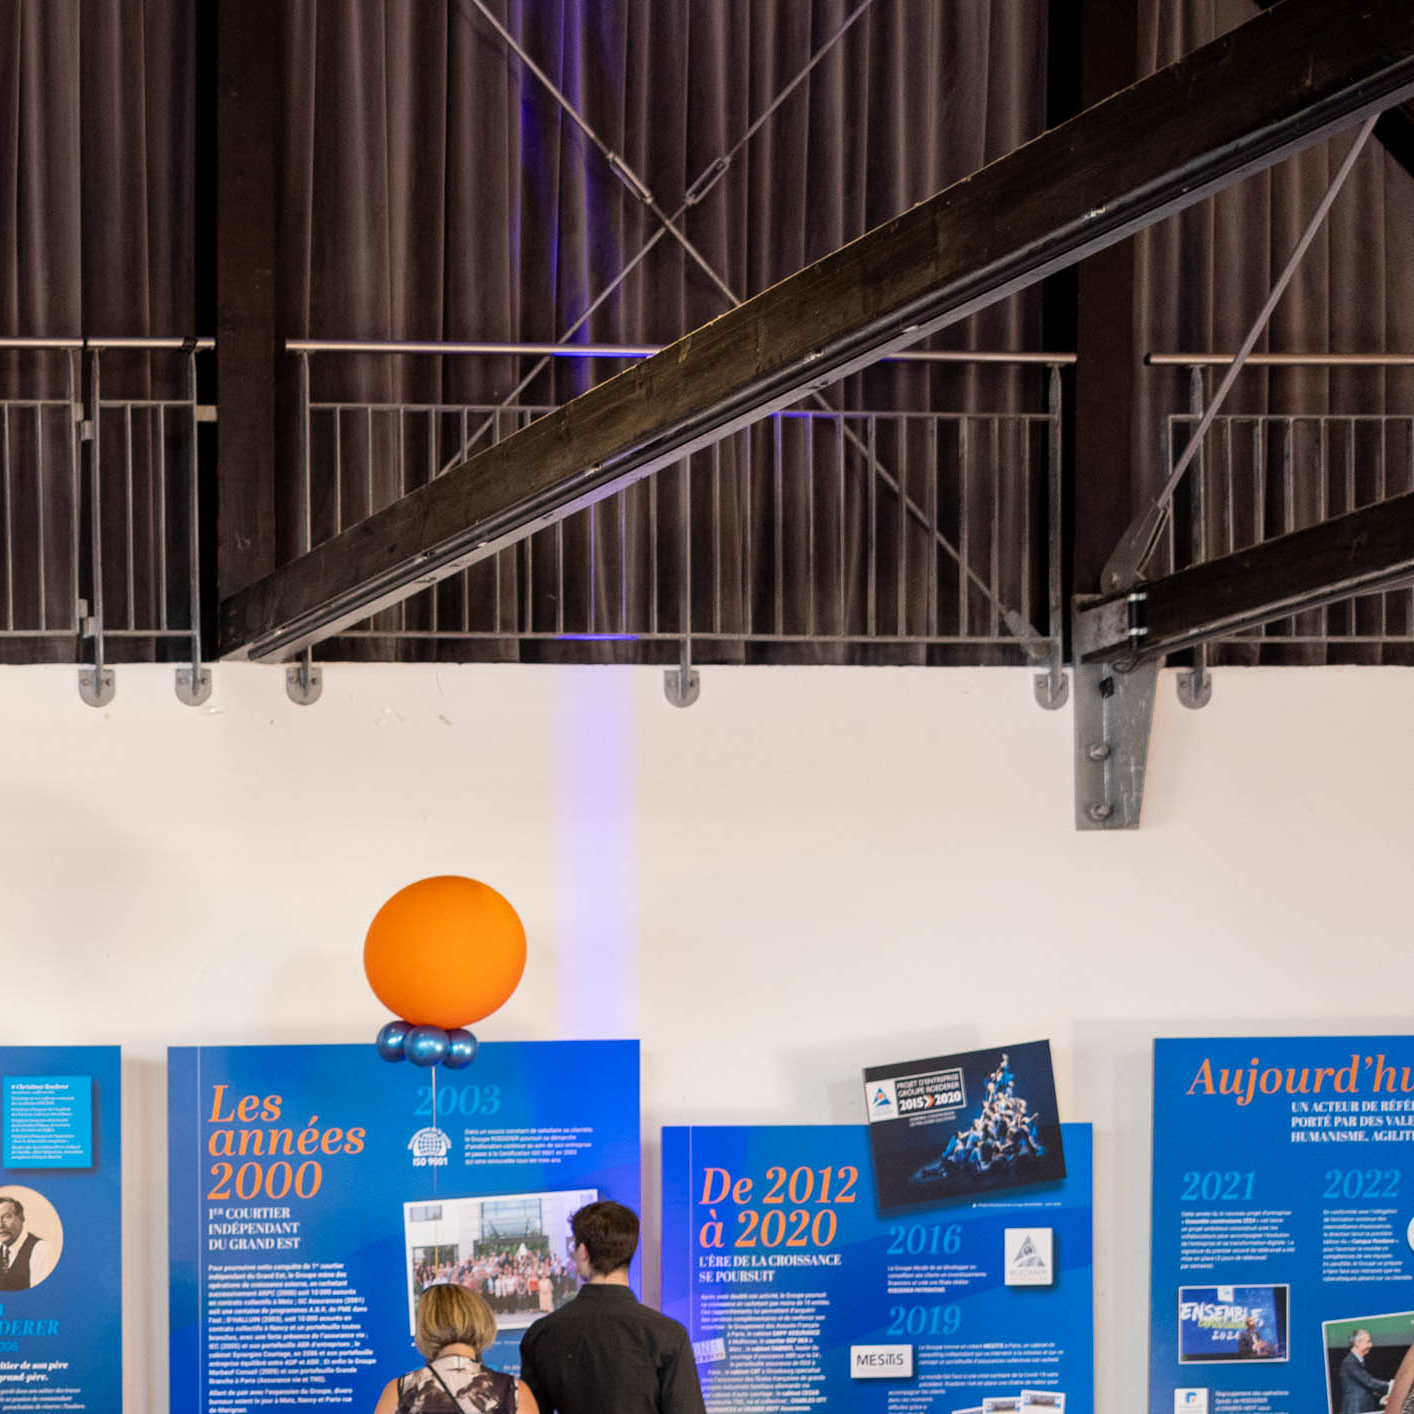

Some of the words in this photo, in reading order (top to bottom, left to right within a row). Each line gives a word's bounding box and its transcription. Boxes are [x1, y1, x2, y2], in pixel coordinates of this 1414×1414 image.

[208, 1086, 282, 1123] Les
[414, 1085, 500, 1116] 2003
[900, 1097, 923, 1111] 2015
[935, 1091, 962, 1105] 2020
[1292, 1102, 1308, 1112] UN
[1310, 1101, 1359, 1112] ACTEUR
[1362, 1101, 1378, 1111] DE
[1292, 1114, 1331, 1127] PORTÉ
[1334, 1116, 1357, 1127] PAR
[1360, 1116, 1383, 1126] DES
[208, 1117, 365, 1156] années
[1291, 1131, 1369, 1143] HUMANISME,
[413, 1158, 427, 1167] ISO
[208, 1161, 322, 1200] 2000
[700, 1167, 753, 1205] De
[762, 1165, 858, 1204] 2012
[1181, 1171, 1256, 1200] 2021
[1322, 1169, 1401, 1199] 2022
[227, 1207, 290, 1219] COURTIER
[209, 1220, 299, 1235] INDÉPENDANT
[700, 1212, 724, 1248] à
[734, 1209, 838, 1248] 2020
[209, 1239, 227, 1250] DU
[230, 1238, 274, 1250] GRAND
[277, 1237, 300, 1249] EST
[886, 1224, 962, 1255] 2016
[734, 1256, 748, 1267] DE
[751, 1255, 765, 1267] LA
[766, 1254, 841, 1267] CROISSANCE
[700, 1272, 714, 1282] SE
[716, 1270, 775, 1282] POURSUIT
[887, 1305, 962, 1336] 2019
[21, 1361, 30, 1369] de
[48, 1361, 68, 1371] père
